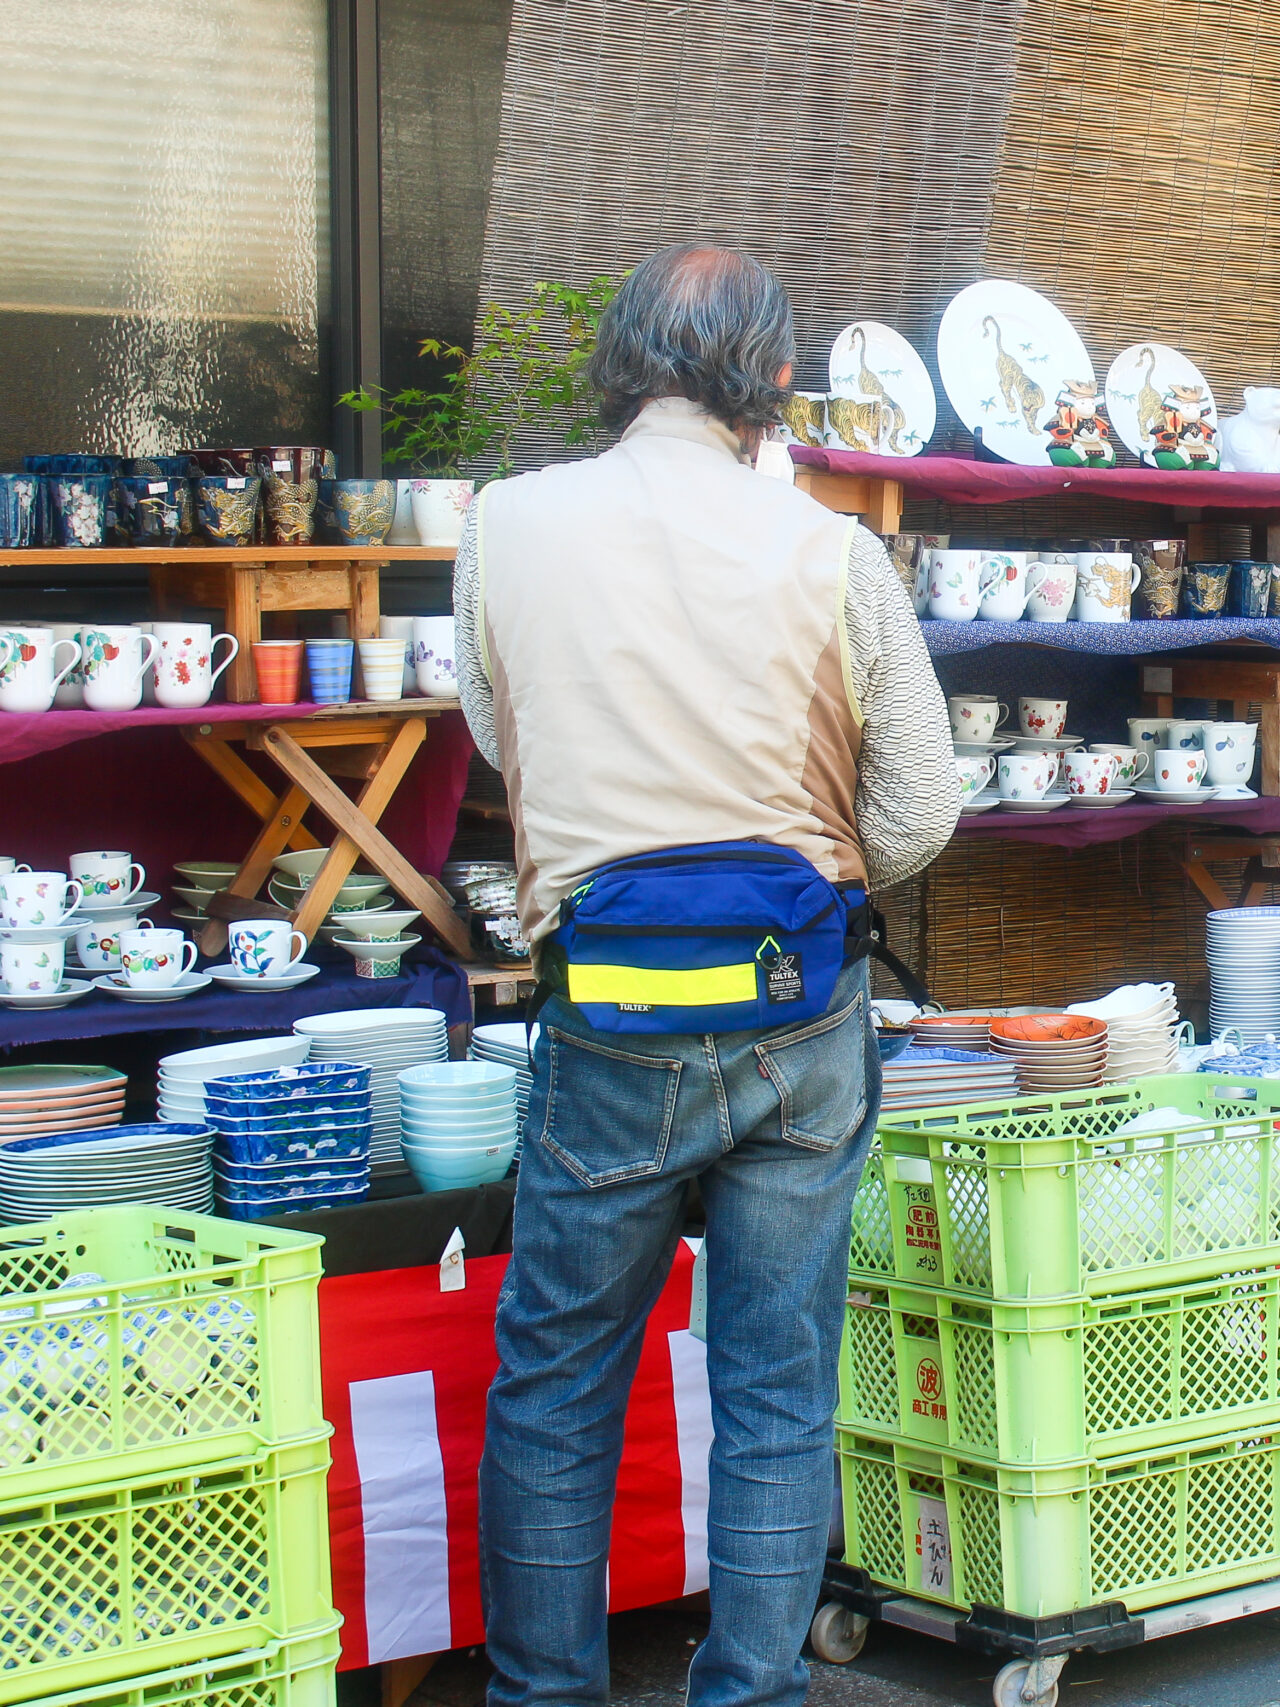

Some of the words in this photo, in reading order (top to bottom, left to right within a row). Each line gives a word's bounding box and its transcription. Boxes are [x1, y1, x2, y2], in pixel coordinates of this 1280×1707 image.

[769, 971, 799, 981] TULTEX
[619, 1003, 649, 1012] TULTEX
[913, 1208, 935, 1224] 肥前
[919, 1365, 939, 1395] 波
[926, 1518, 946, 1586] 土びん
